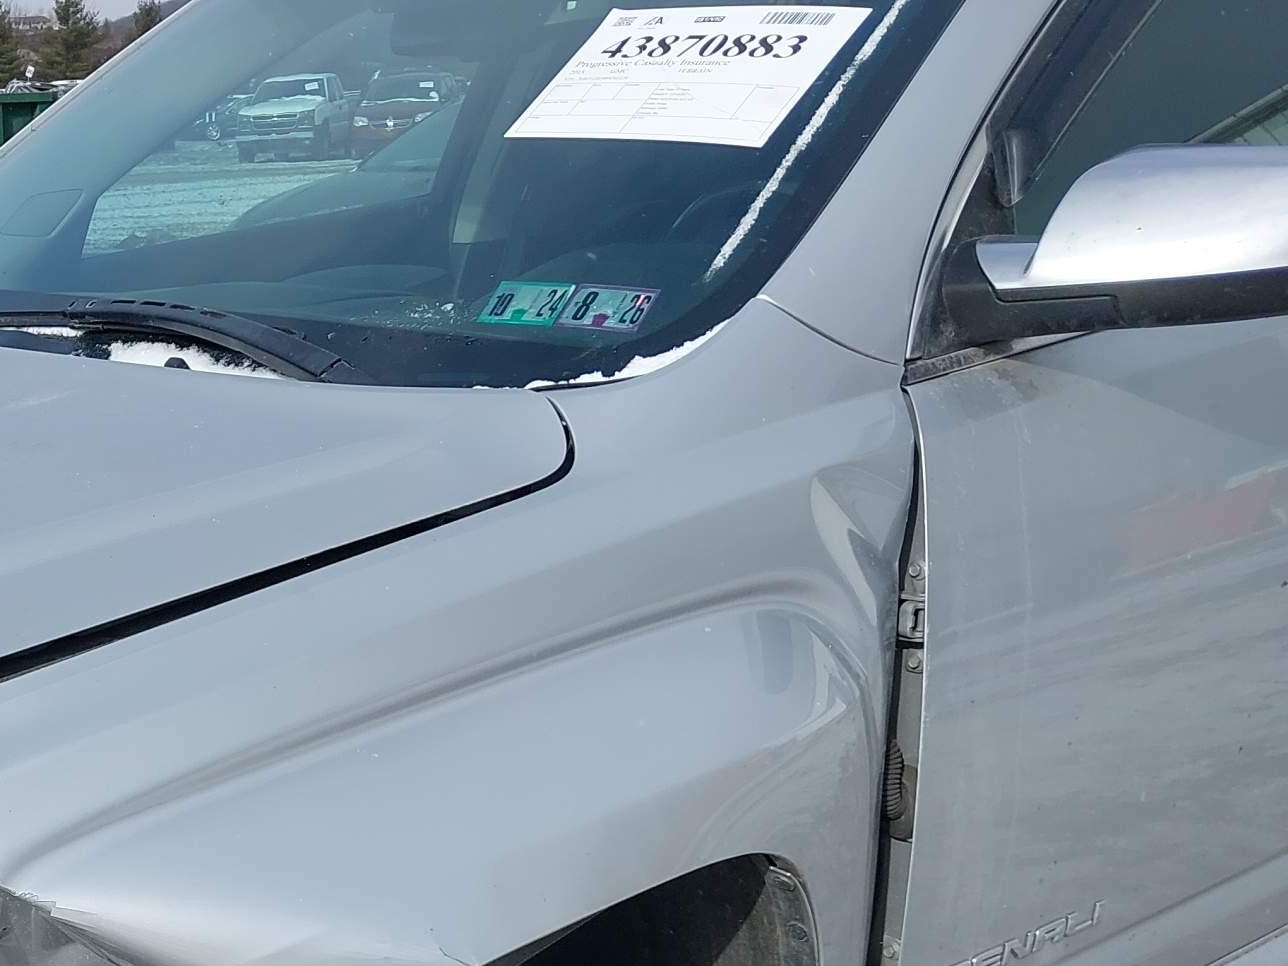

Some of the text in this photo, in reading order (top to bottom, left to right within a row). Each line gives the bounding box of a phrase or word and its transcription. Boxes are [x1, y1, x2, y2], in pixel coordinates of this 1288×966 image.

[601, 34, 808, 59] 43870883
[535, 289, 568, 318] 24
[571, 291, 652, 324] 8 26
